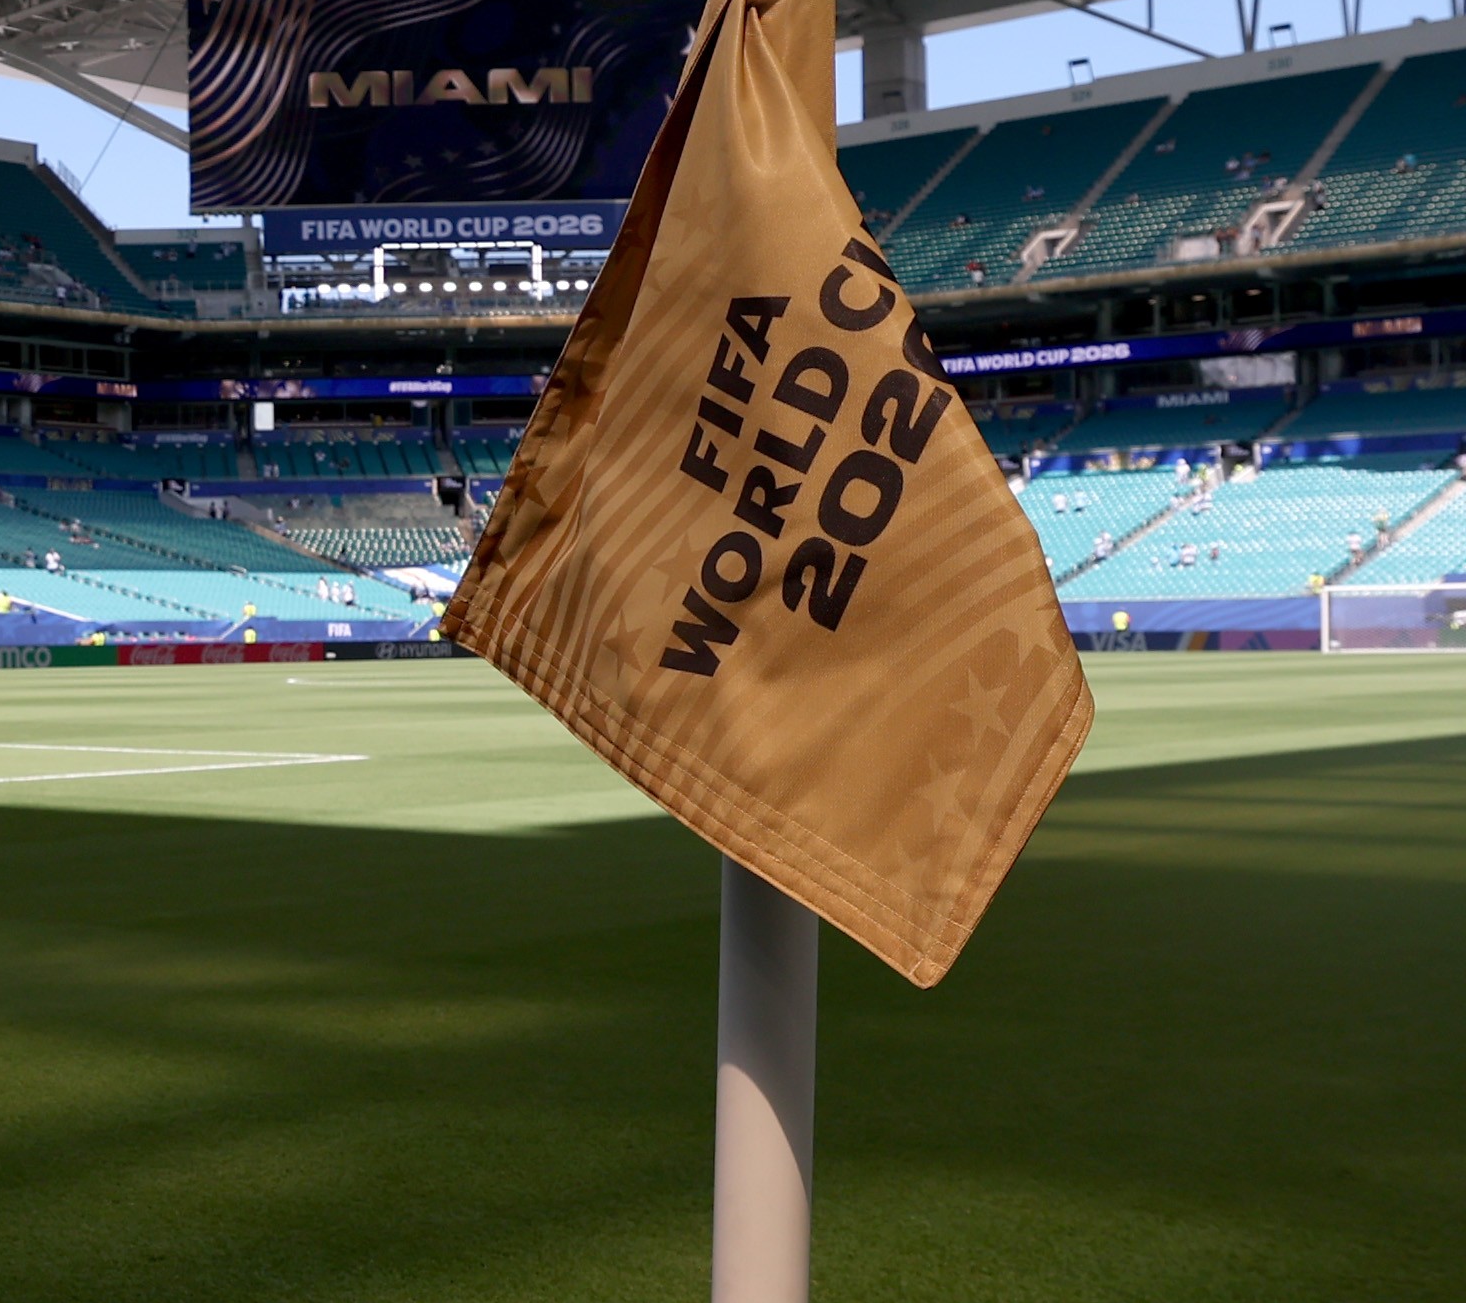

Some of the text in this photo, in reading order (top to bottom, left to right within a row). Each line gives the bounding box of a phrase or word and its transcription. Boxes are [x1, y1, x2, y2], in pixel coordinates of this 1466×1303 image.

[309, 66, 593, 108] MIAMI
[302, 214, 604, 241] FIFA WORLD CUP 2026
[976, 352, 1035, 371] WORLD
[1035, 348, 1070, 366] CUP
[1069, 342, 1131, 363] 2026
[680, 296, 791, 493] FIFA
[1156, 391, 1230, 408] MIAMI
[659, 346, 850, 677] WORLD
[328, 623, 352, 637] FIFA
[1090, 631, 1148, 652] VISA
[398, 644, 453, 657] HYUNDAI
